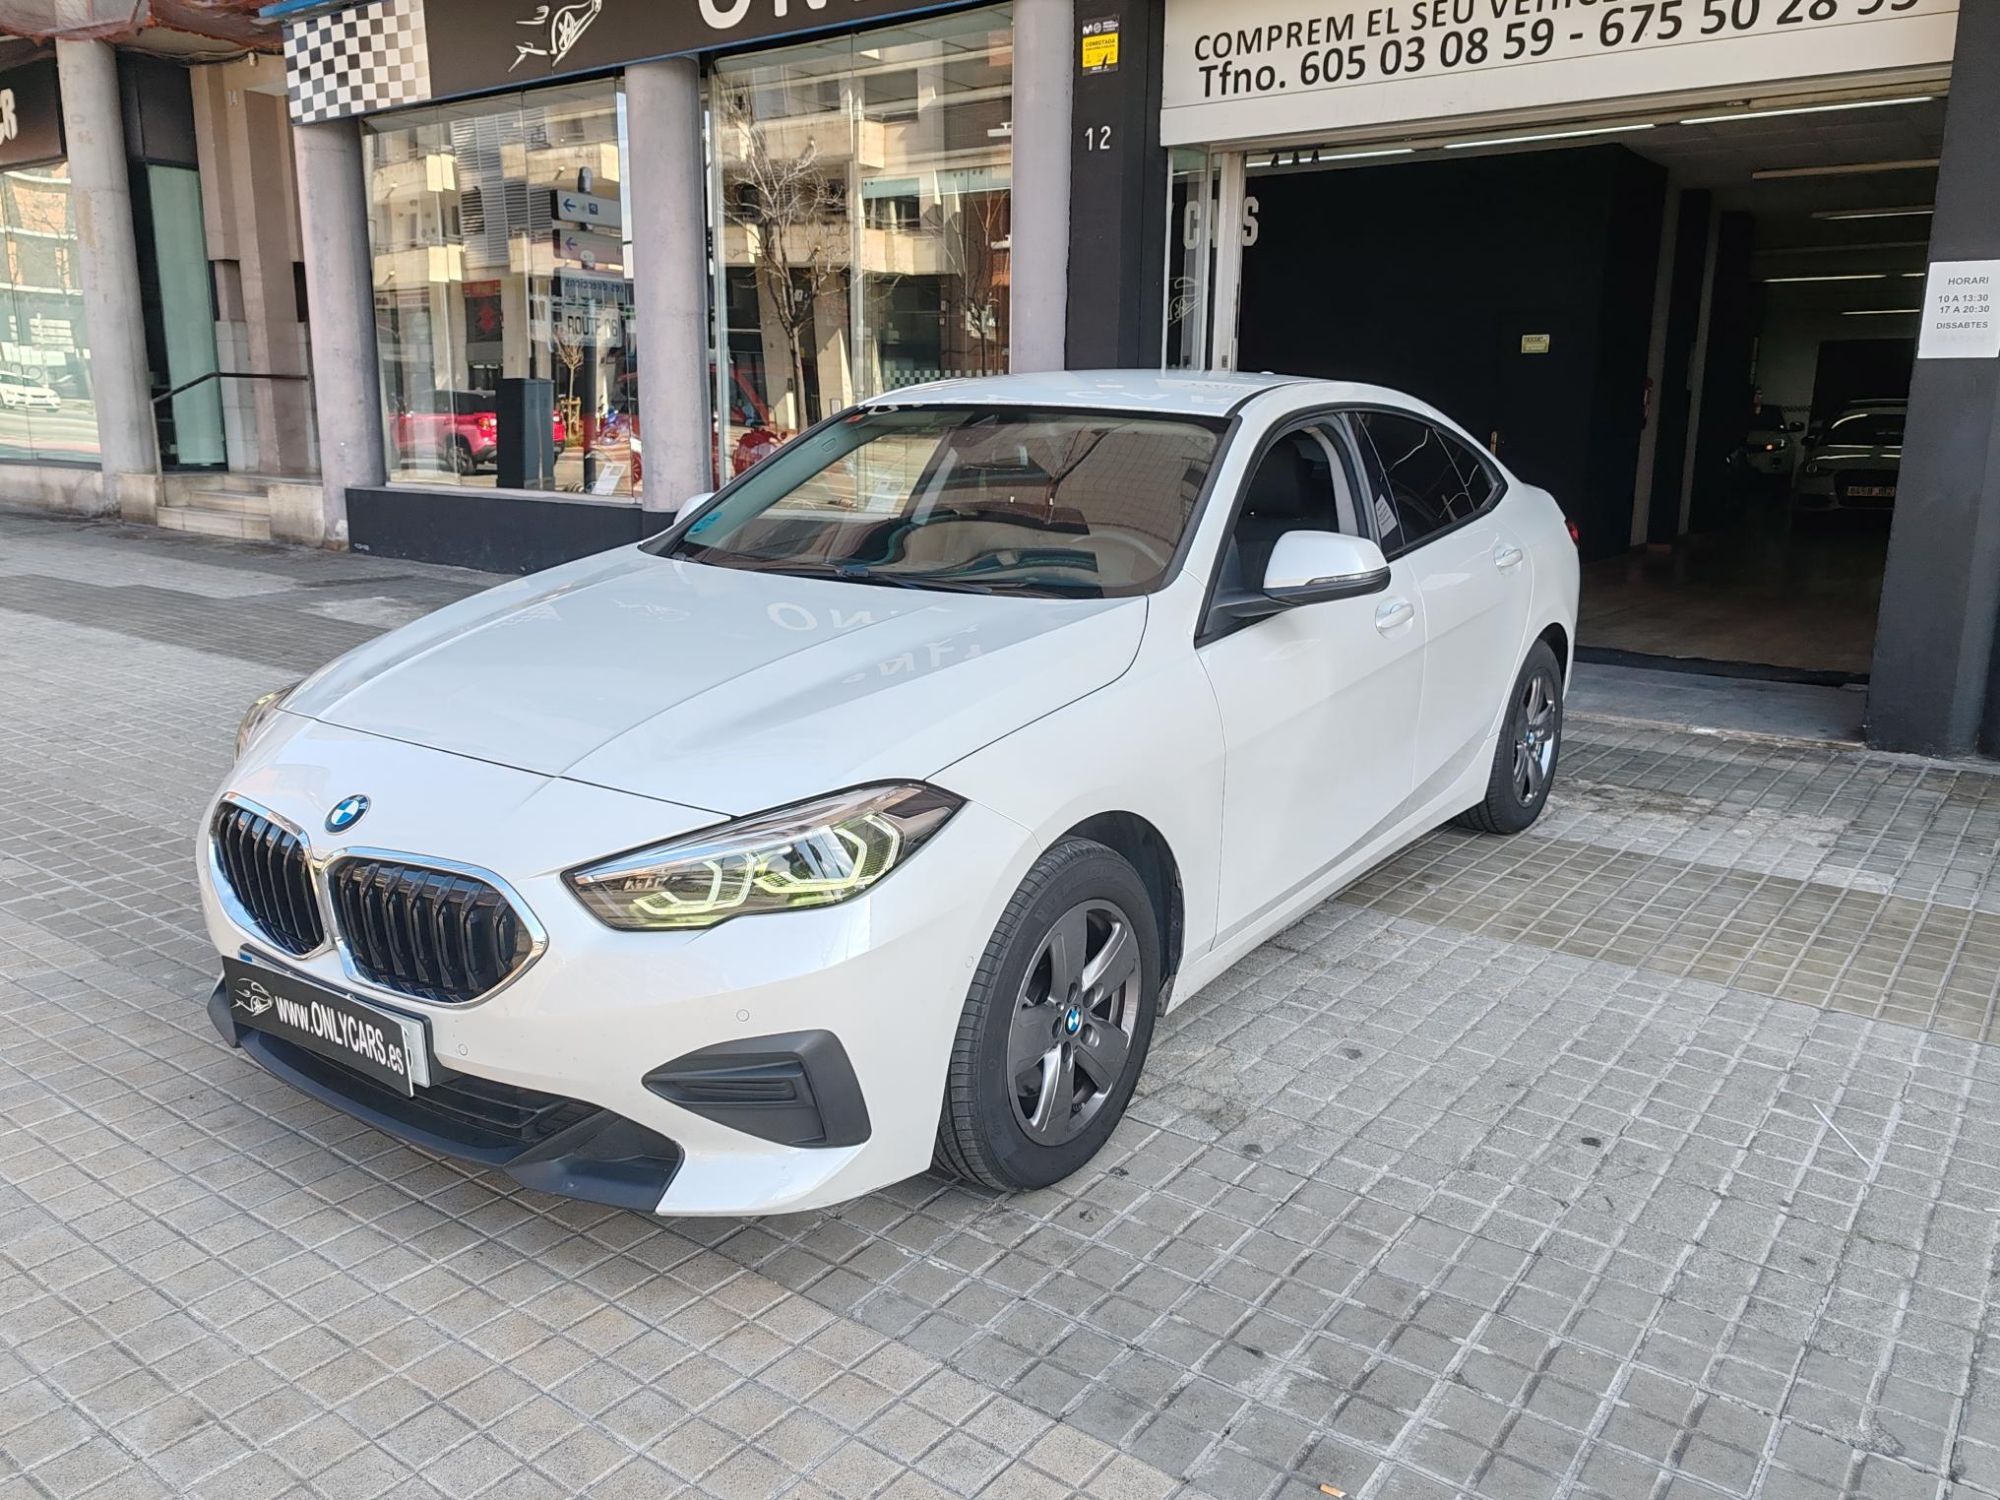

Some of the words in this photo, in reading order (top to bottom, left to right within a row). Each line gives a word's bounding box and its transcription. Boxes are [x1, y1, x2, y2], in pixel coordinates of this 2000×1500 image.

[1195, 13, 1354, 61] COMPREM
[1367, 7, 1399, 37] EL
[1411, 0, 1475, 30] SEU
[1199, 61, 1286, 98] Tfno.
[1300, 45, 1366, 85] 605
[1380, 36, 1425, 75] 03
[1440, 27, 1489, 67] 08
[1503, 18, 1554, 60] 59
[1600, 0, 1682, 47] 675
[1700, 0, 1759, 34] 50
[1085, 125, 1111, 151] 12
[1948, 277, 1989, 285] HORARI
[1939, 295, 1950, 303] 10
[1962, 294, 1988, 302] 13:30
[1963, 305, 1990, 313] 20:30
[1936, 321, 1988, 329] DISSABTES
[275, 996, 404, 1075] www.ONLYCARS.es
